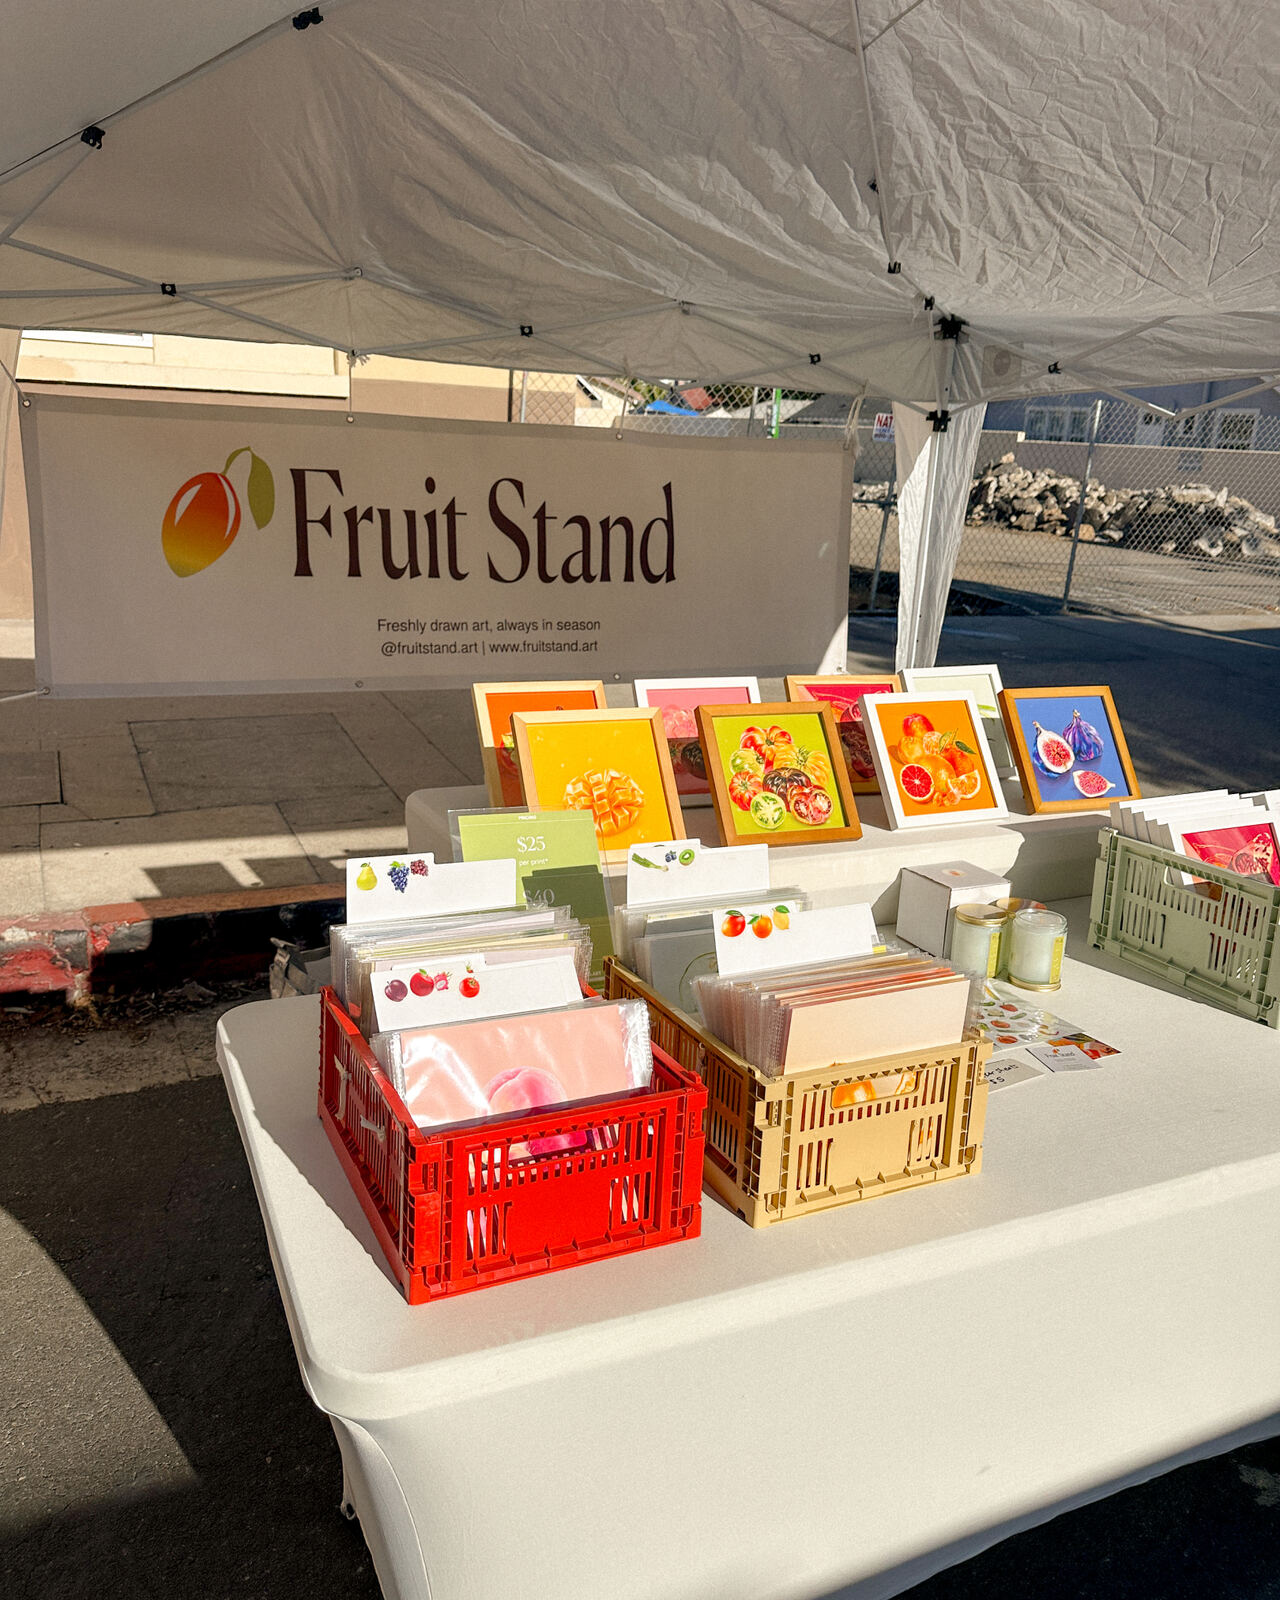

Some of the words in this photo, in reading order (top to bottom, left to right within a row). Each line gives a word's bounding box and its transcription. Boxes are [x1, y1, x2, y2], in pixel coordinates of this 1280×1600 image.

[876, 415, 894, 428] NAT
[289, 468, 470, 581] Fruit
[487, 477, 677, 584] Stand
[377, 618, 427, 635] Freshly
[430, 618, 469, 632] drawn
[472, 619, 493, 633] art,
[496, 618, 539, 634] always
[542, 618, 553, 631] in
[556, 620, 601, 631] season
[381, 641, 478, 657] @fruitstand.art
[489, 639, 599, 653] www.fruitstand.art
[517, 836, 546, 853] $25
